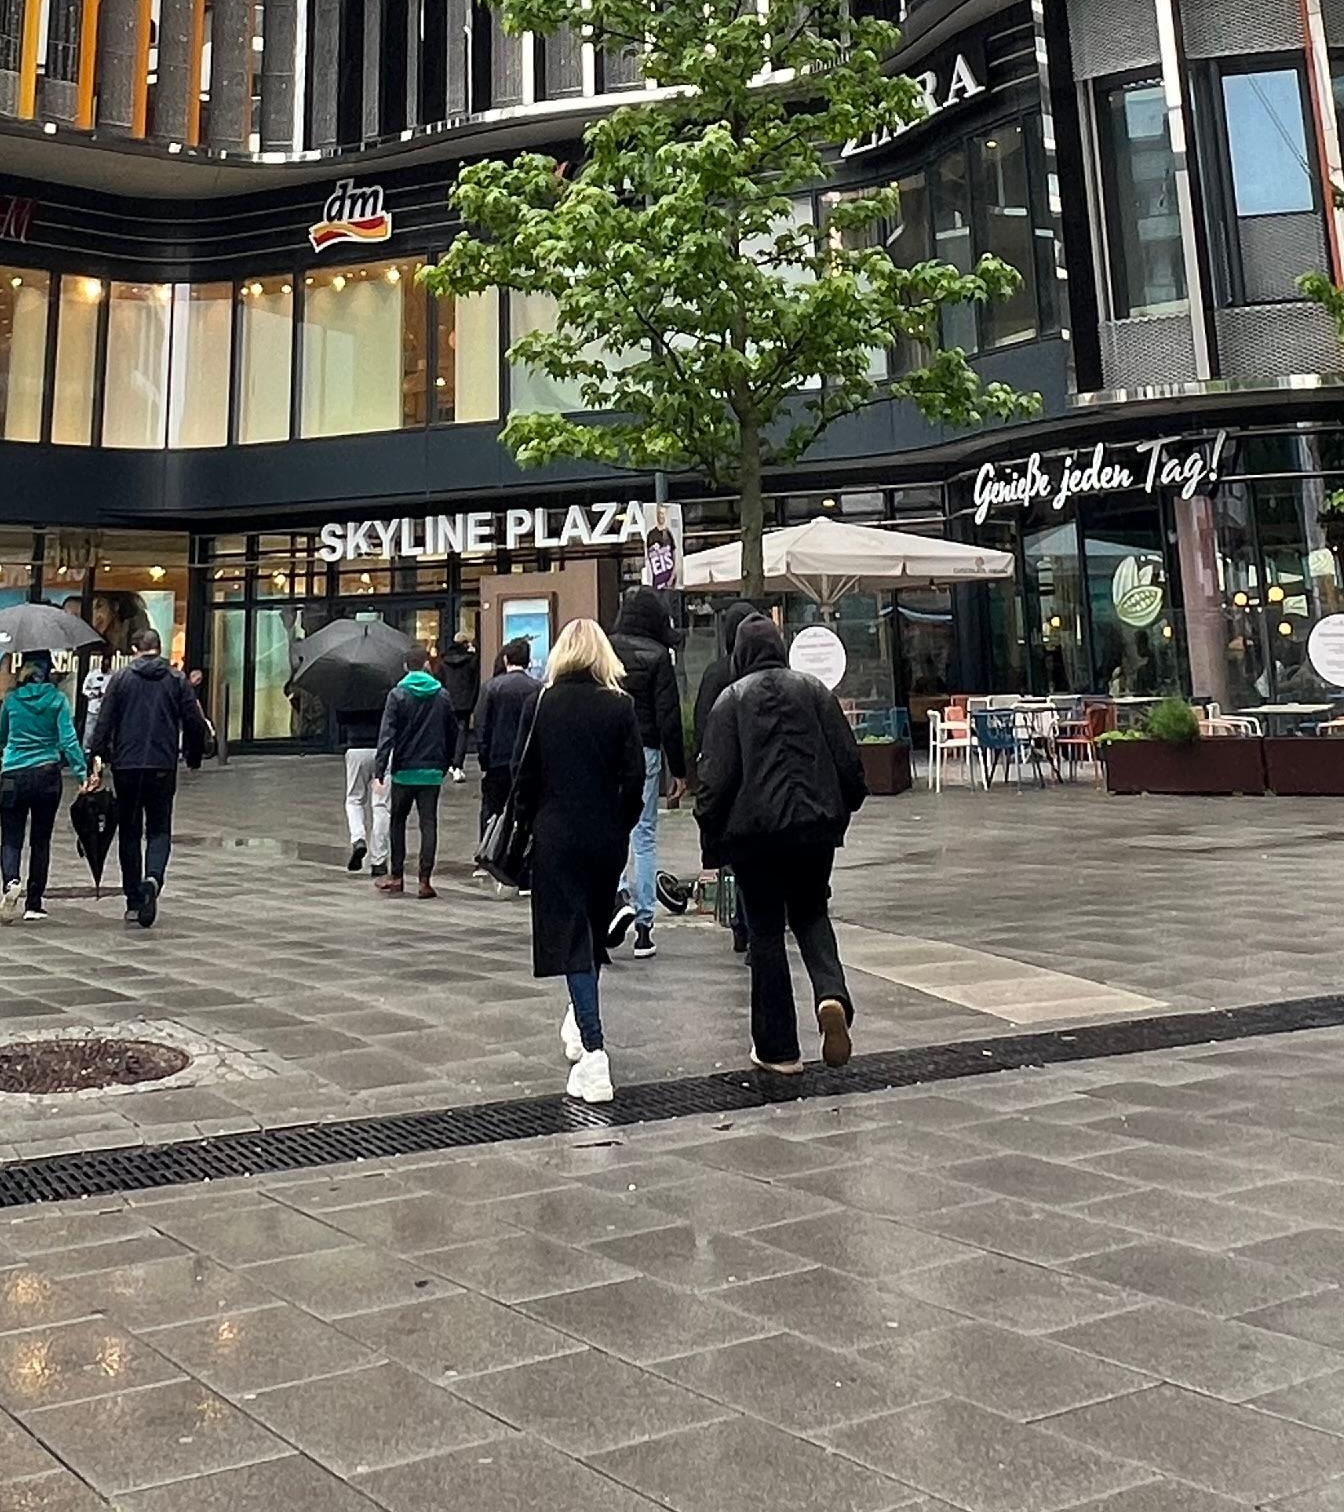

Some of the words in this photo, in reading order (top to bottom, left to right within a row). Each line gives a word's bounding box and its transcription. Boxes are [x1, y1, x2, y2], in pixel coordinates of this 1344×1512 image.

[323, 178, 383, 224] dm
[973, 451, 1052, 525] Genieße
[1052, 442, 1134, 510] jeden
[1136, 429, 1228, 501] Tag!
[320, 510, 496, 563] SKYLINE
[505, 500, 647, 550] PLAZA
